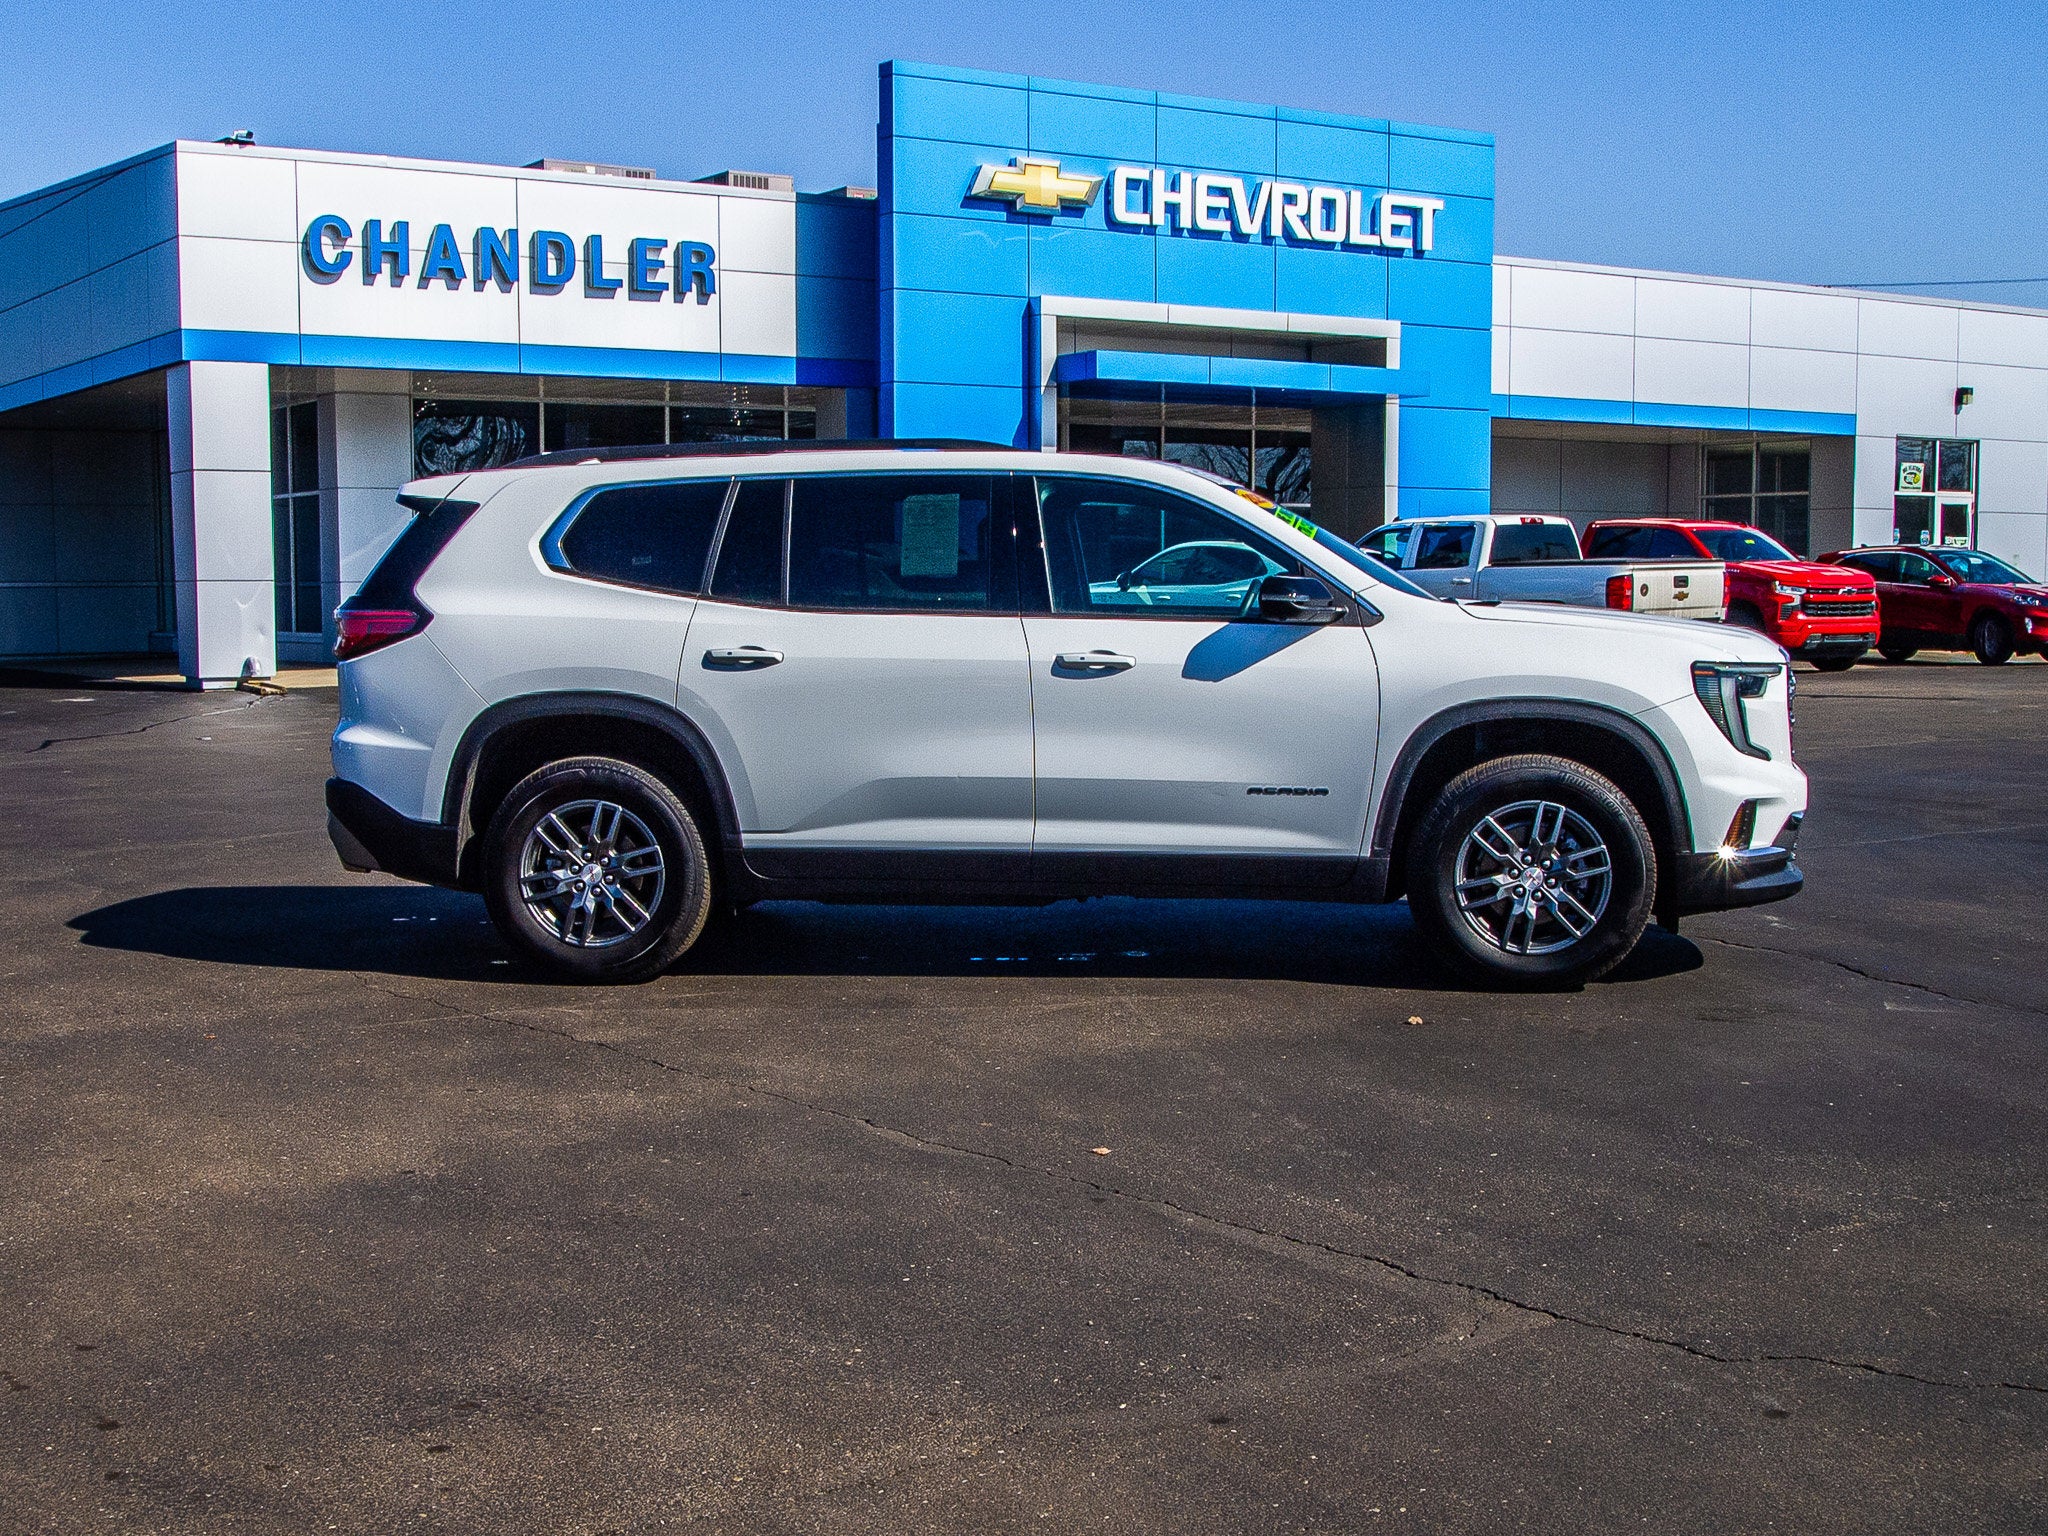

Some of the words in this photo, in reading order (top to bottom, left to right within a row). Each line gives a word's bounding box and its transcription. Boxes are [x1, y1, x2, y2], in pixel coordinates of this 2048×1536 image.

[1112, 166, 1445, 252] CHEVROLET
[303, 214, 717, 301] CHANDLER
[1246, 786, 1330, 797] ACADIA
